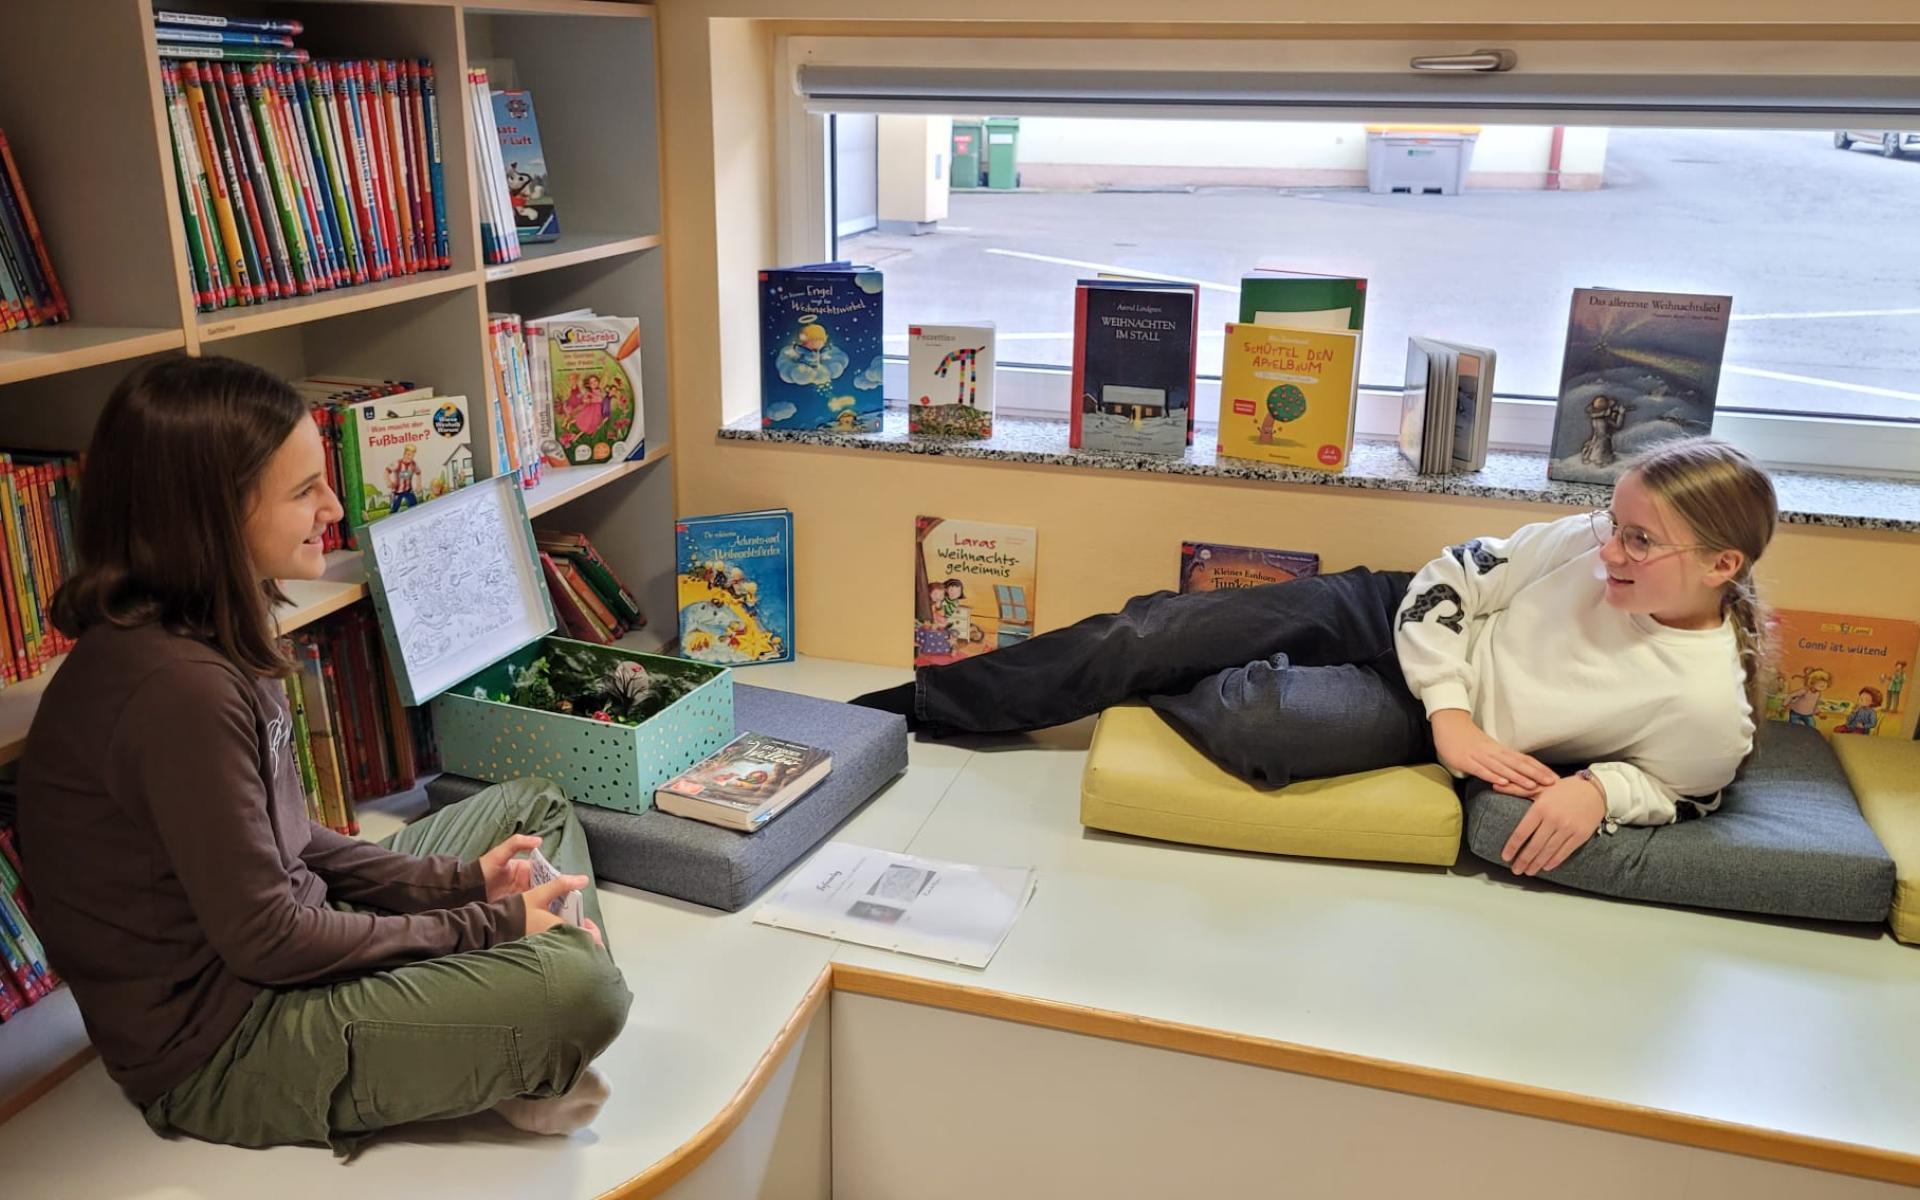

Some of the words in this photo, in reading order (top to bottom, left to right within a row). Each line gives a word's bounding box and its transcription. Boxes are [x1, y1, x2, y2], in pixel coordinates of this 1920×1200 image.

[807, 285, 833, 298] Engel
[791, 299, 866, 315] Weihnachtswirbel
[1651, 299, 1721, 313] Weihnachtslied
[1101, 316, 1176, 330] WEIHNACHTEN
[576, 332, 615, 342] Leserabe
[1116, 329, 1128, 339] IM
[1130, 330, 1160, 341] STALL
[1307, 348, 1334, 362] DEN
[368, 429, 431, 447] Fußballer?
[954, 533, 997, 549] Laras
[937, 548, 1020, 566] Weihnachts-
[946, 562, 1011, 578] geheimnis
[1214, 567, 1242, 577] Kleines
[1244, 569, 1277, 583] Einhorn
[1798, 638, 1828, 650] Conni
[1830, 641, 1844, 653] ist
[1847, 643, 1887, 657] wütend
